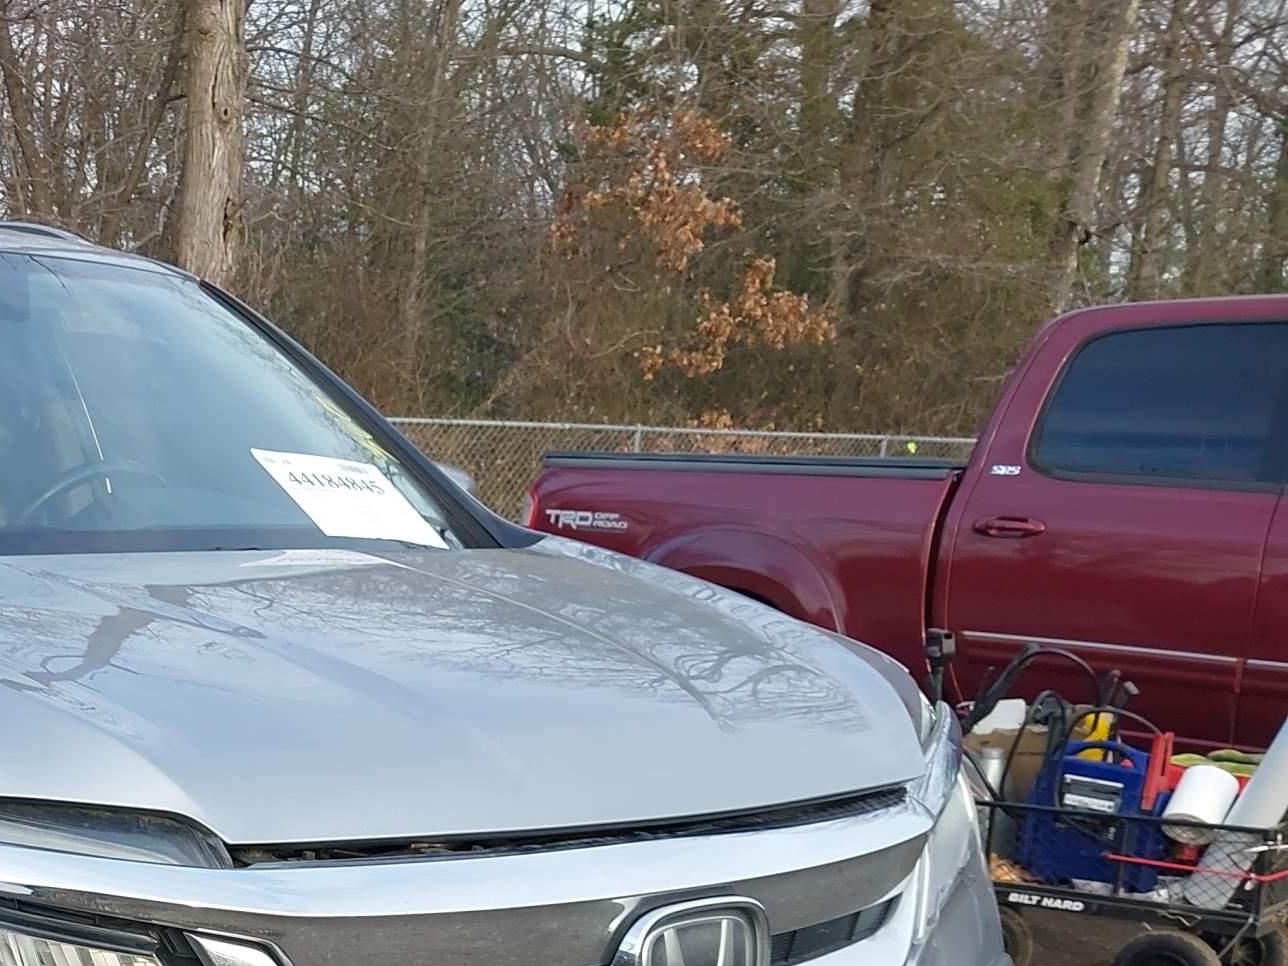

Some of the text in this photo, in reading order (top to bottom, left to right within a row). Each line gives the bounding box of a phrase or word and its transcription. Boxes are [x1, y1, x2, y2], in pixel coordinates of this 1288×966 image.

[288, 470, 385, 496] 44184845
[545, 508, 593, 530] TRD
[592, 520, 628, 529] ROAD
[1008, 892, 1085, 912] BILT HARD
